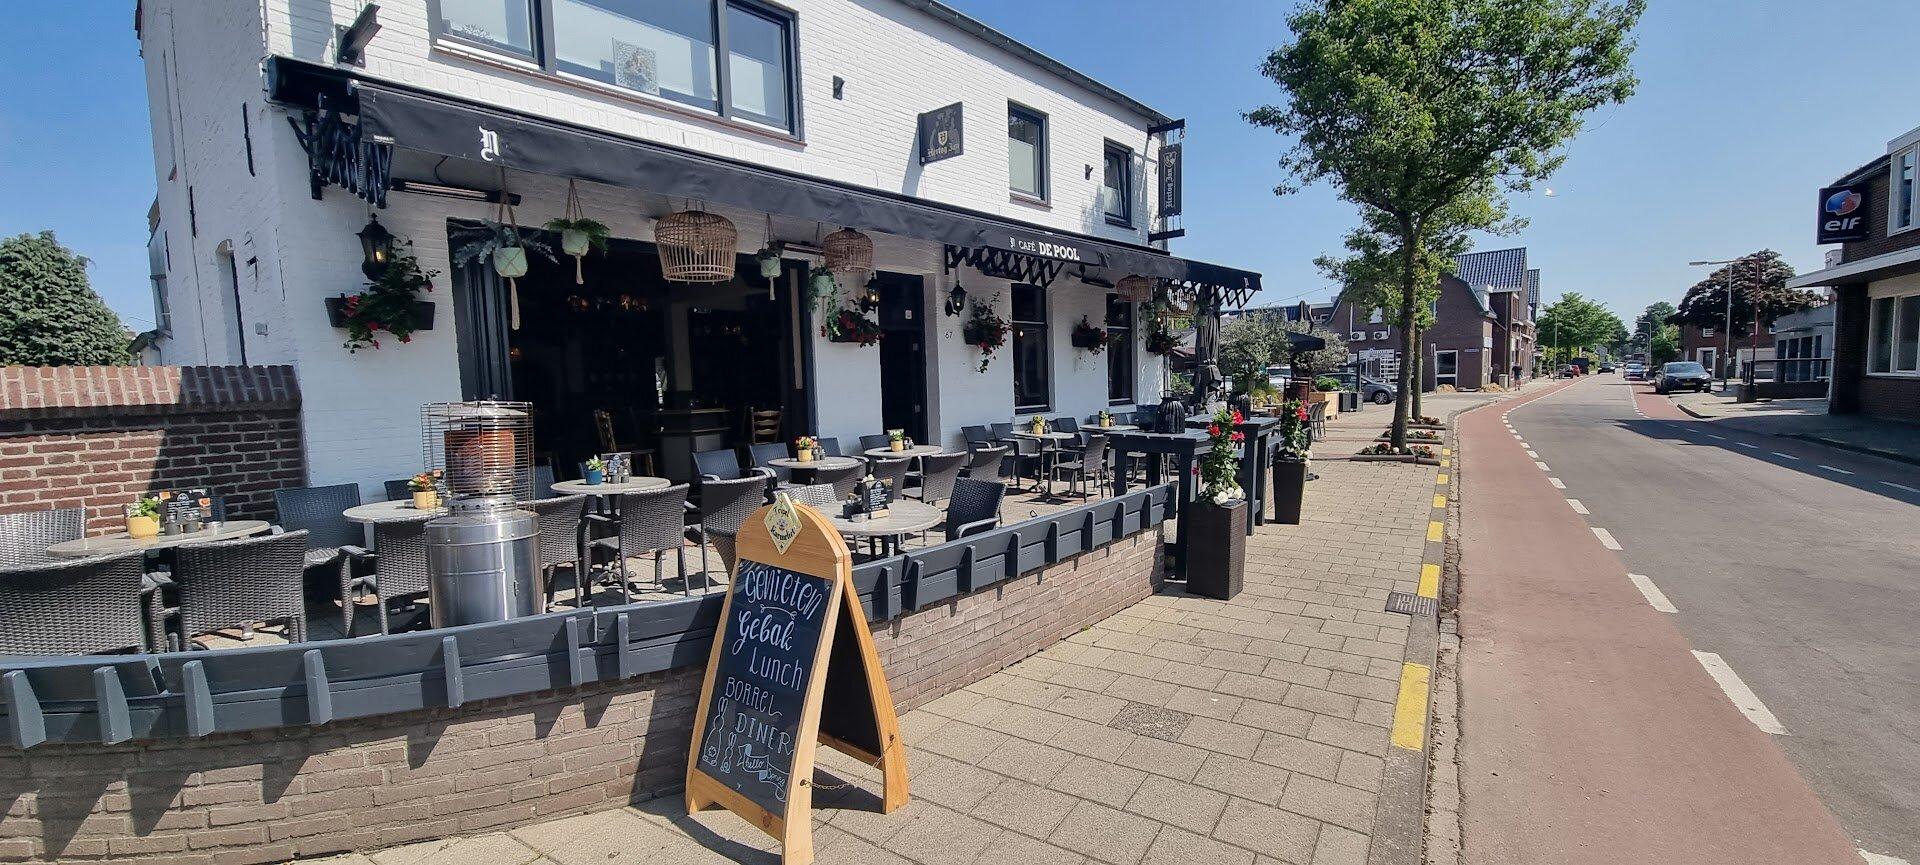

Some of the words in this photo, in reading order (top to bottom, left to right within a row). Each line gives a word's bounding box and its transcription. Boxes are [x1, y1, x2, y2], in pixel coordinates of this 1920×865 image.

[1165, 168, 1174, 182] Jan
[1165, 182, 1174, 208] Hertog
[1824, 216, 1861, 231] elf
[1018, 240, 1037, 252] CAFÉ
[1039, 242, 1053, 257] DE
[1053, 244, 1081, 261] POOL
[945, 331, 953, 339] 67
[749, 646, 803, 691] Lunch
[734, 712, 794, 756] DINER
[745, 758, 765, 769] hello
